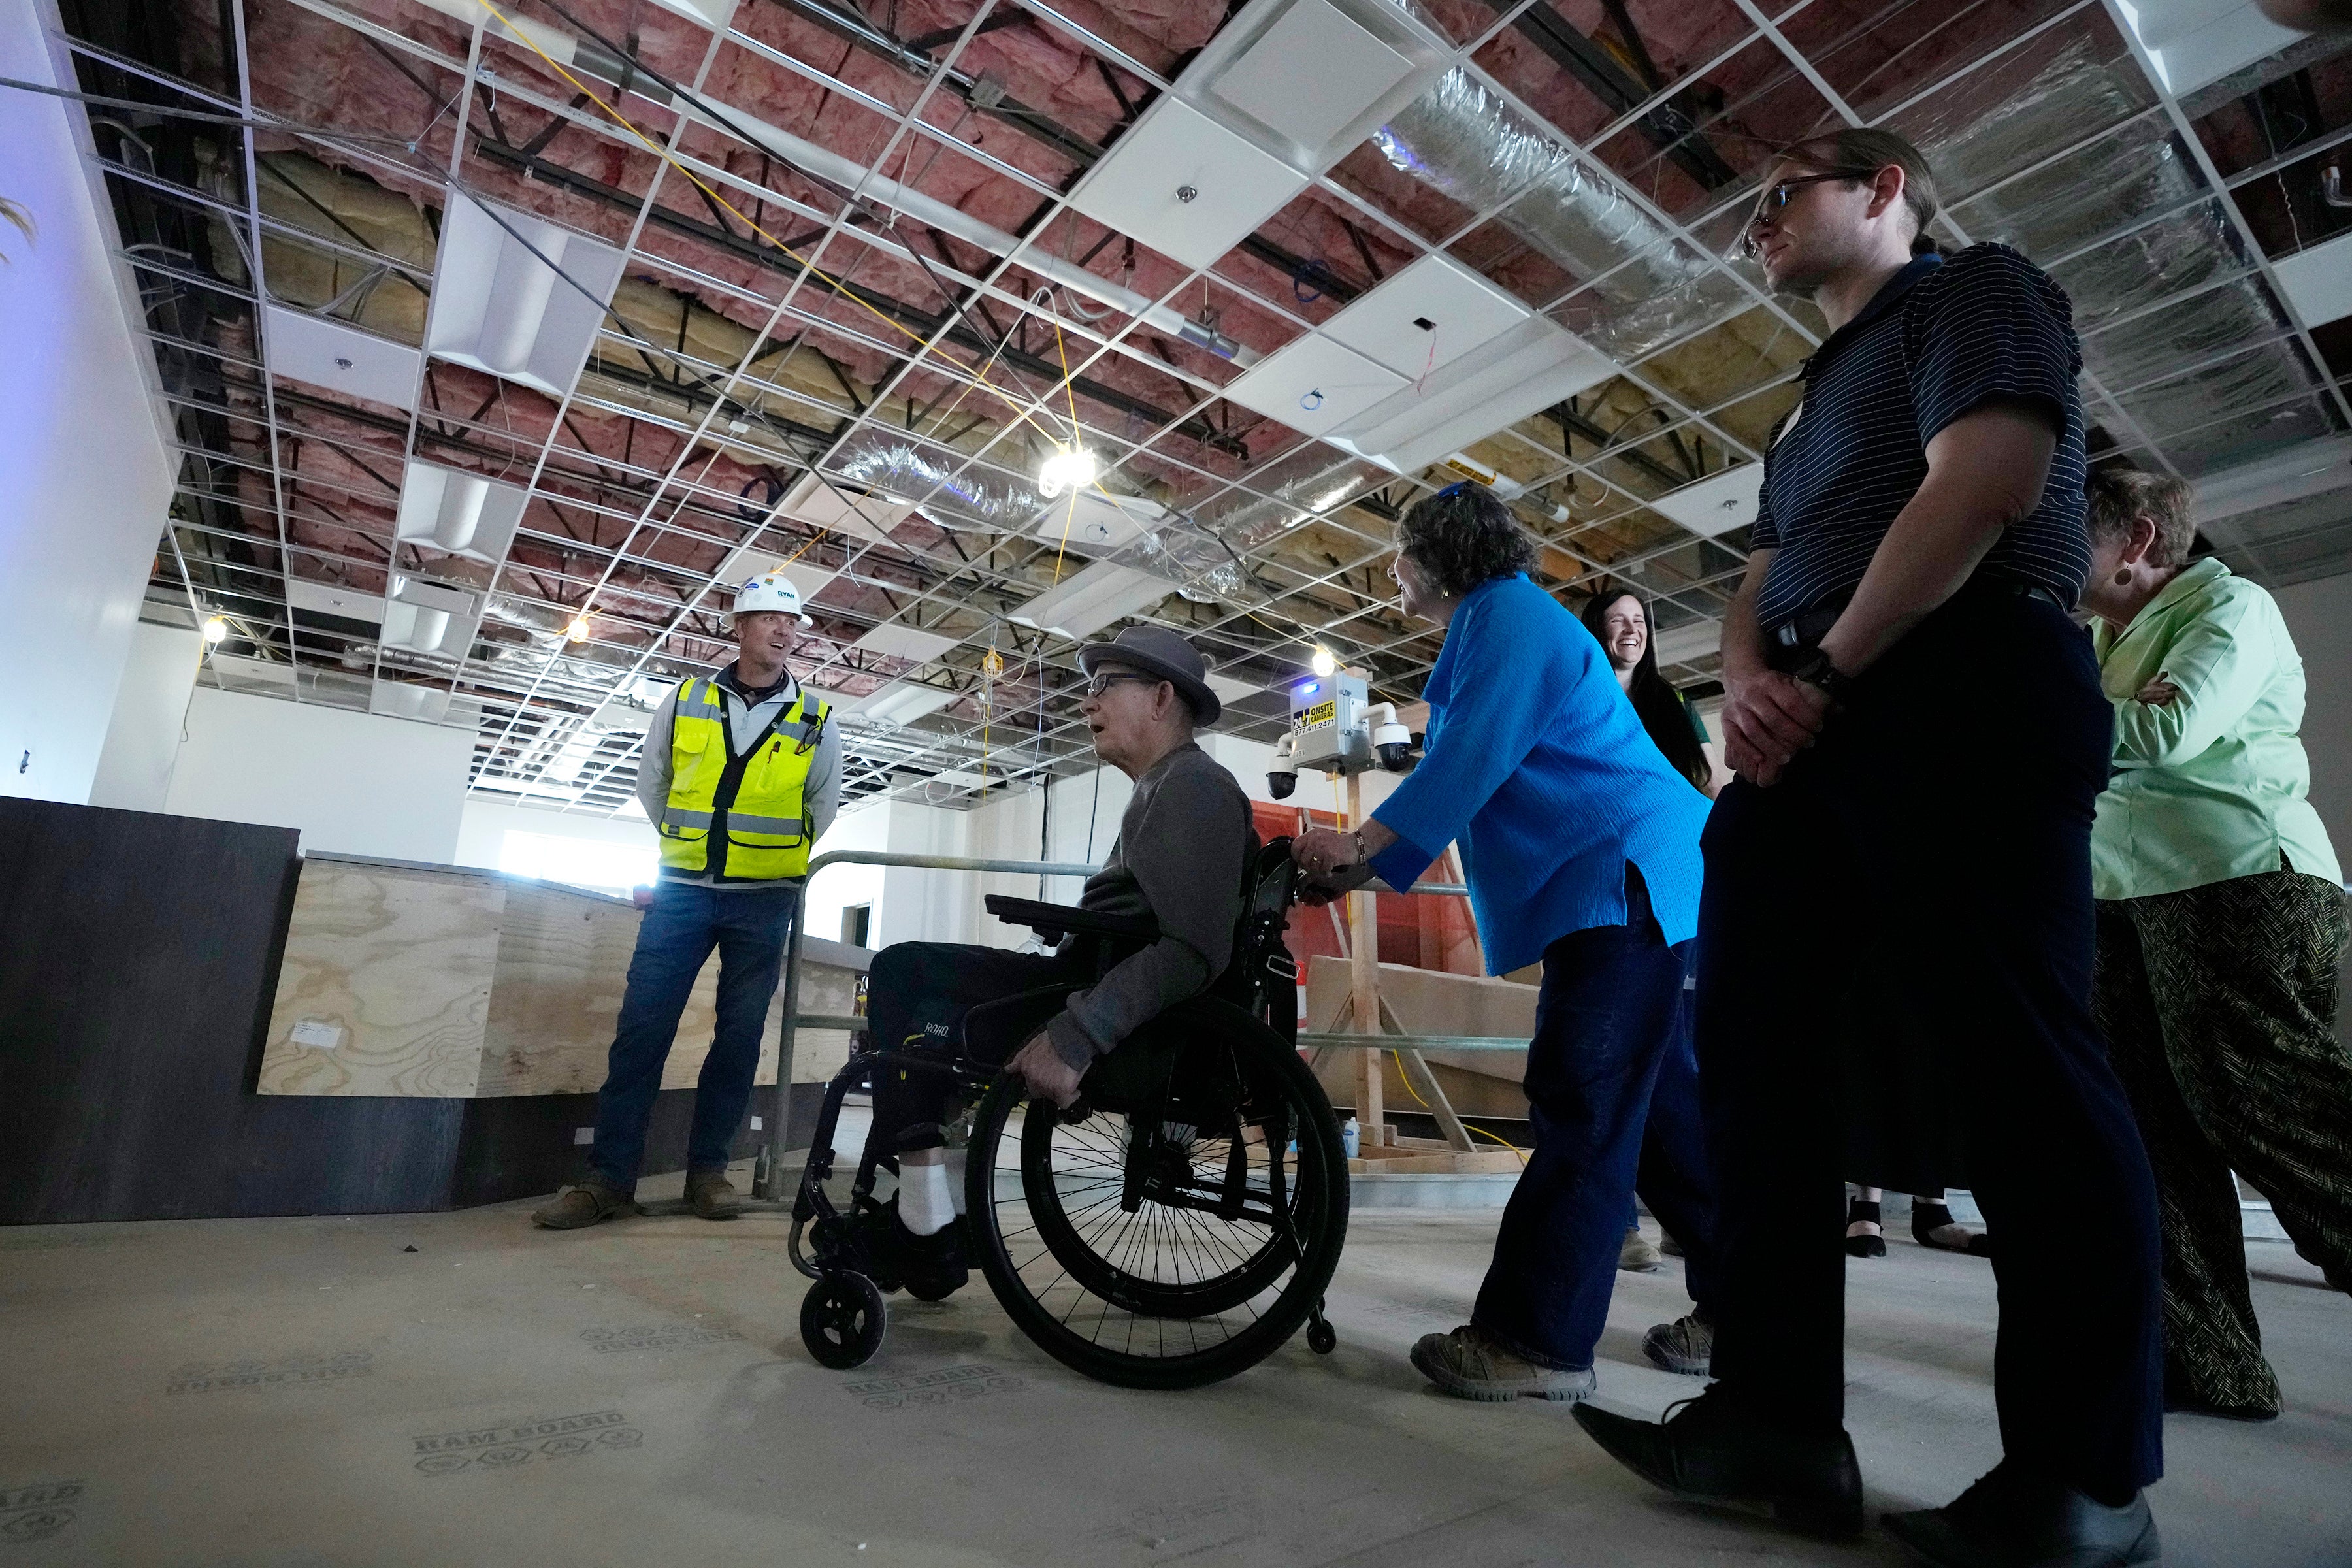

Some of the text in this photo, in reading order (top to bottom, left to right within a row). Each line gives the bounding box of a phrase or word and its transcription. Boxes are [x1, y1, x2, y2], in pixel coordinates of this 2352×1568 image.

[777, 591, 795, 599] RYAN
[1311, 702, 1333, 716] ONSITE
[1311, 711, 1333, 723] CAMERAS
[1294, 719, 1334, 736] 877.411.2471
[924, 1022, 949, 1037] ROHO
[414, 1411, 626, 1450] RAM BOARD
